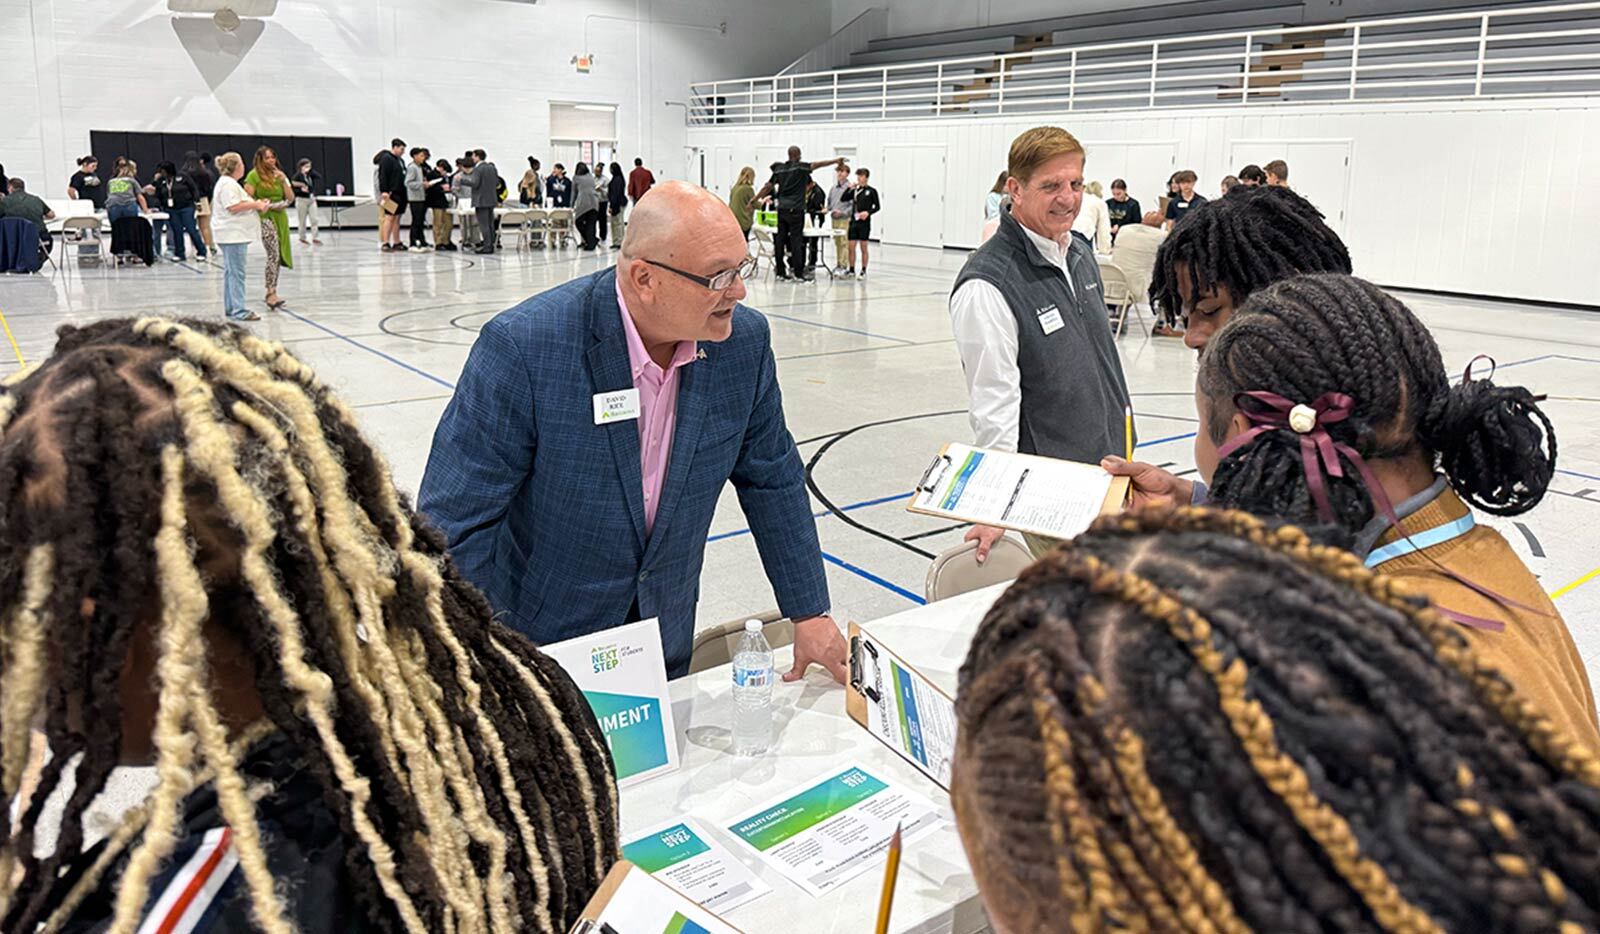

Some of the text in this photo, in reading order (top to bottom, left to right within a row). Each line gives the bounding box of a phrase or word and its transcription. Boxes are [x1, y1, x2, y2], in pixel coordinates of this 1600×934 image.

[591, 648, 618, 664] NEXT
[593, 659, 619, 674] STEP
[661, 830, 687, 843] NEXT
[665, 834, 691, 848] STEP
